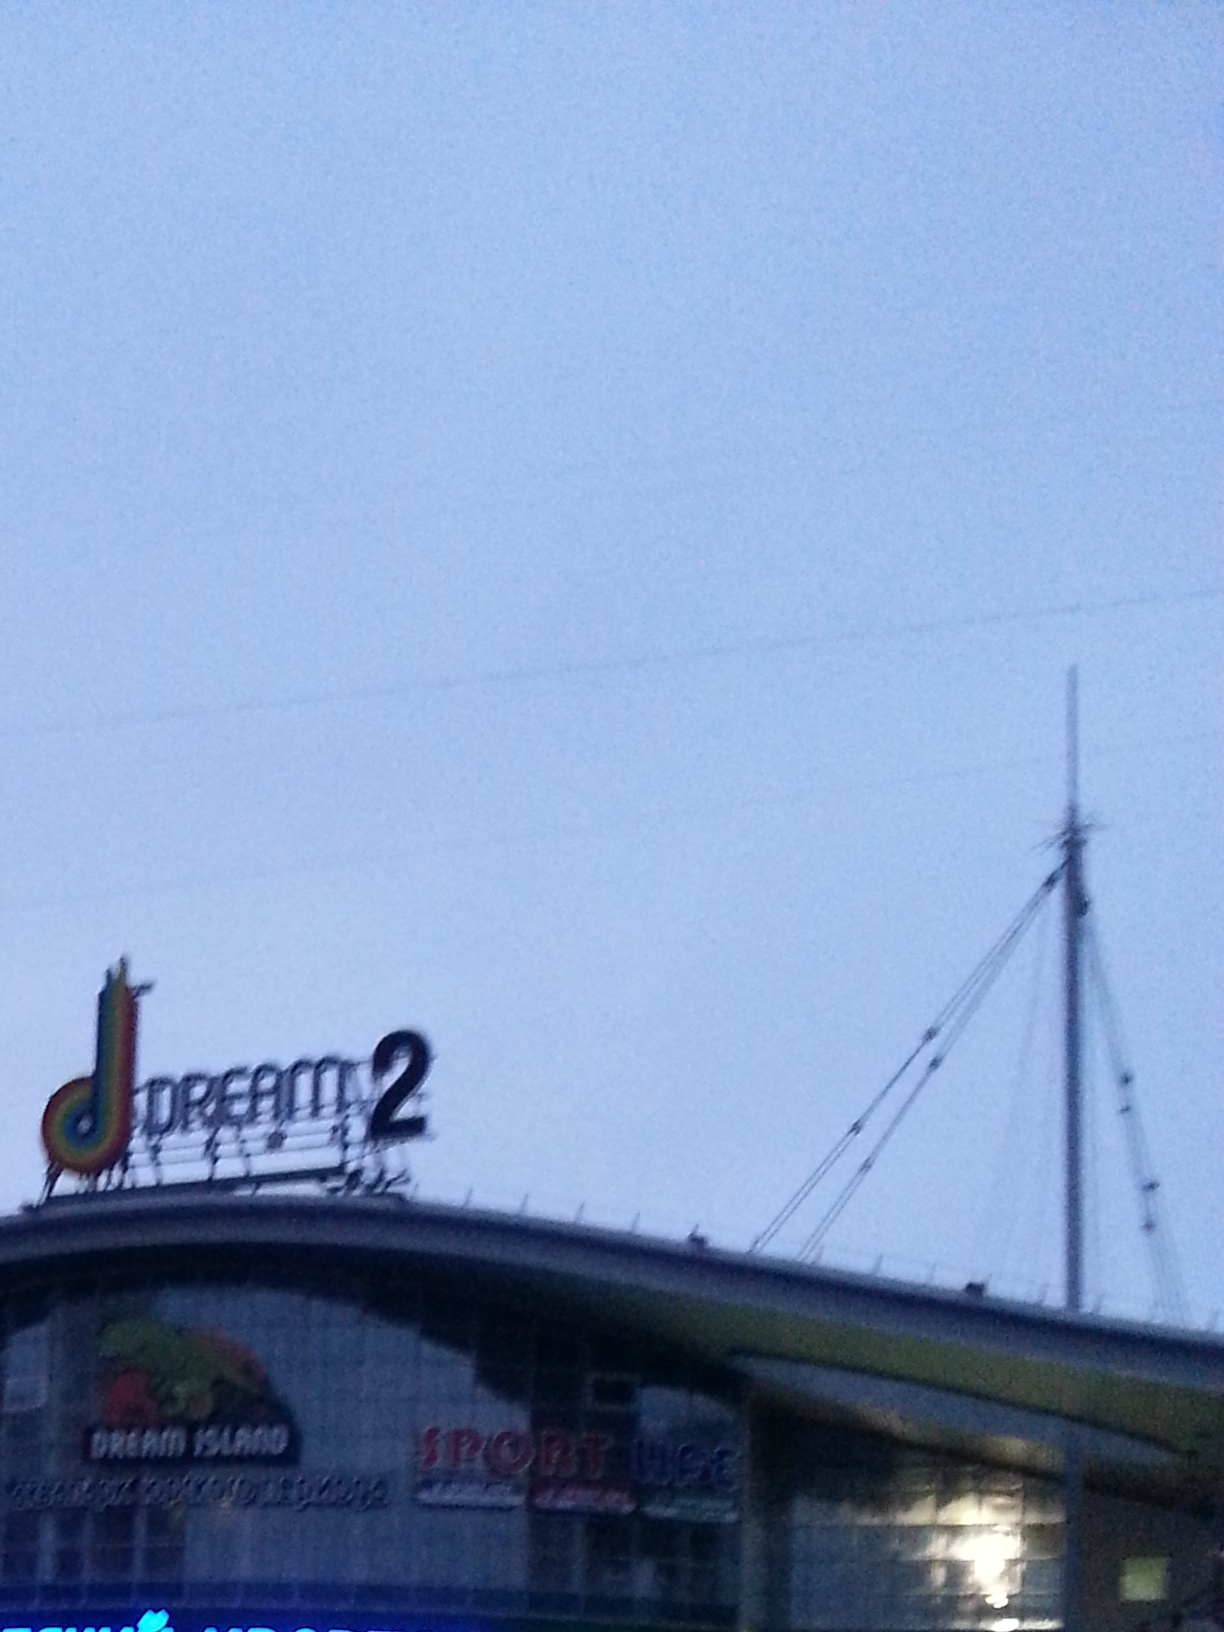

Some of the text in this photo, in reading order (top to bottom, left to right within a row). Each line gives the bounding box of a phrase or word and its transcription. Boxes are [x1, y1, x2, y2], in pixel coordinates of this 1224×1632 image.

[140, 1029, 432, 1140] DREAM 2
[89, 1422, 291, 1460] DREAM ISLAND
[420, 1425, 612, 1478] SPORT
